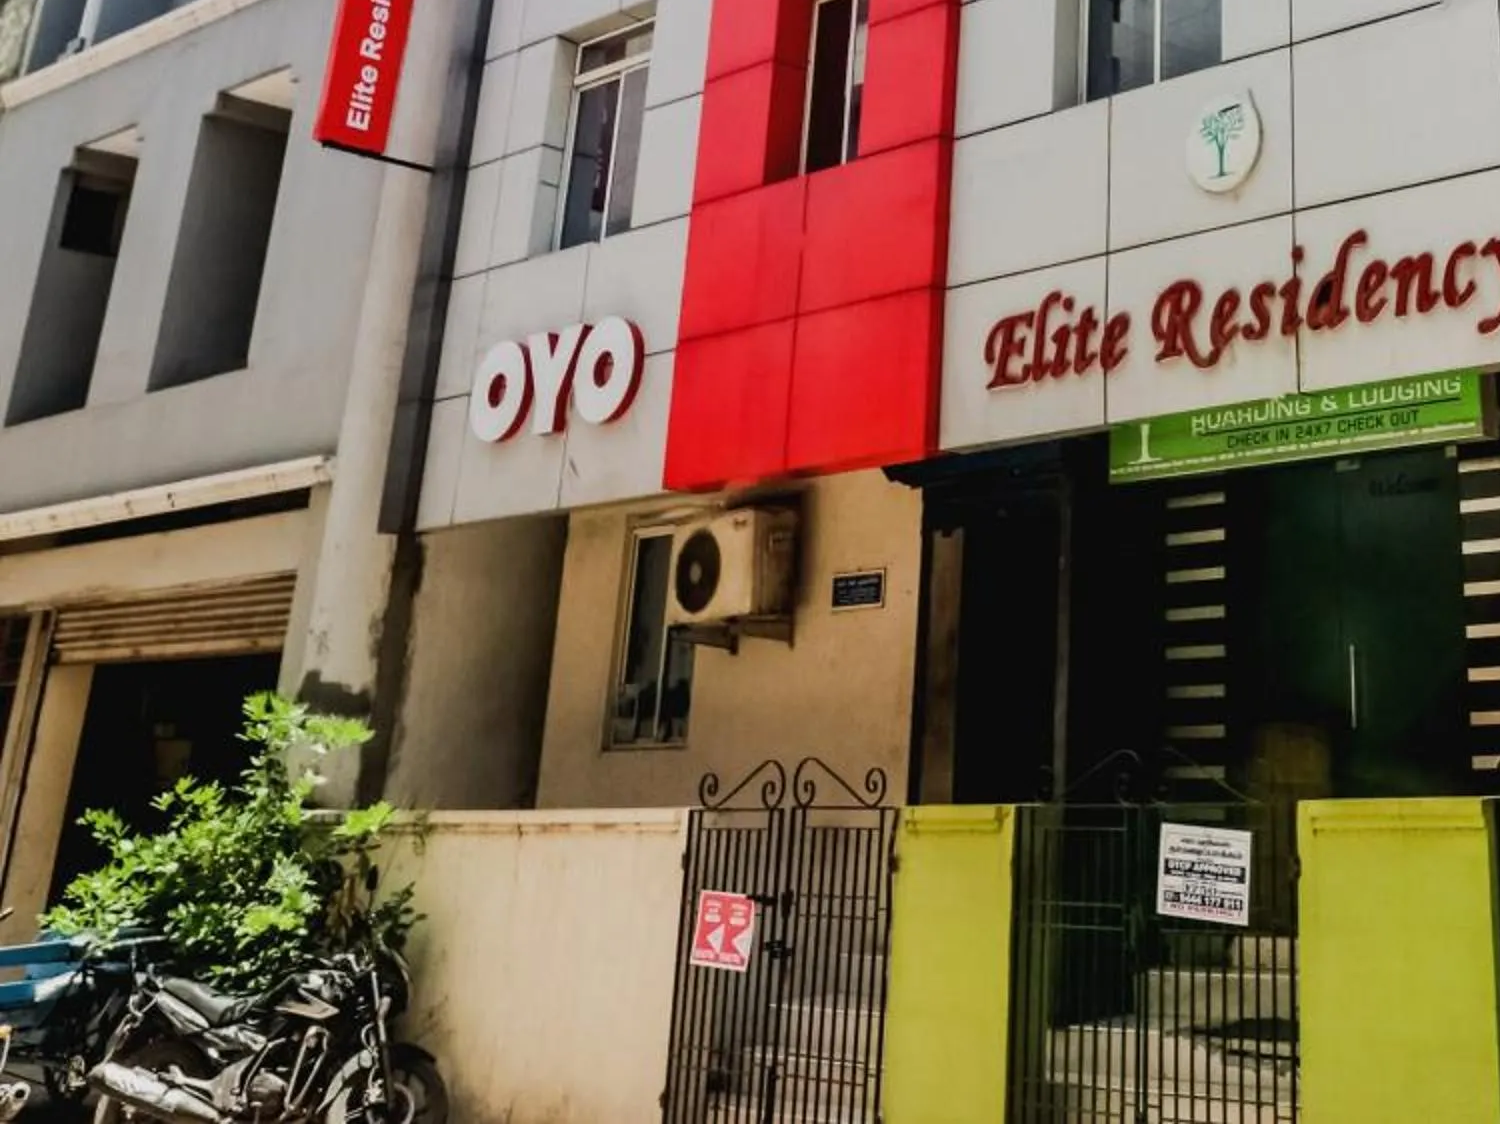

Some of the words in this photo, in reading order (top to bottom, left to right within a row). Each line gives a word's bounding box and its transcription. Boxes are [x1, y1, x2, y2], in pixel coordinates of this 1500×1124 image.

[346, 67, 379, 132] Elite
[469, 314, 646, 443] OYO
[984, 289, 1131, 391] Elite
[1227, 429, 1270, 449] CHECK
[1275, 427, 1289, 443] IN
[1295, 422, 1331, 440] 24X7
[1337, 414, 1385, 433] CHECK
[1390, 409, 1420, 426] OUT
